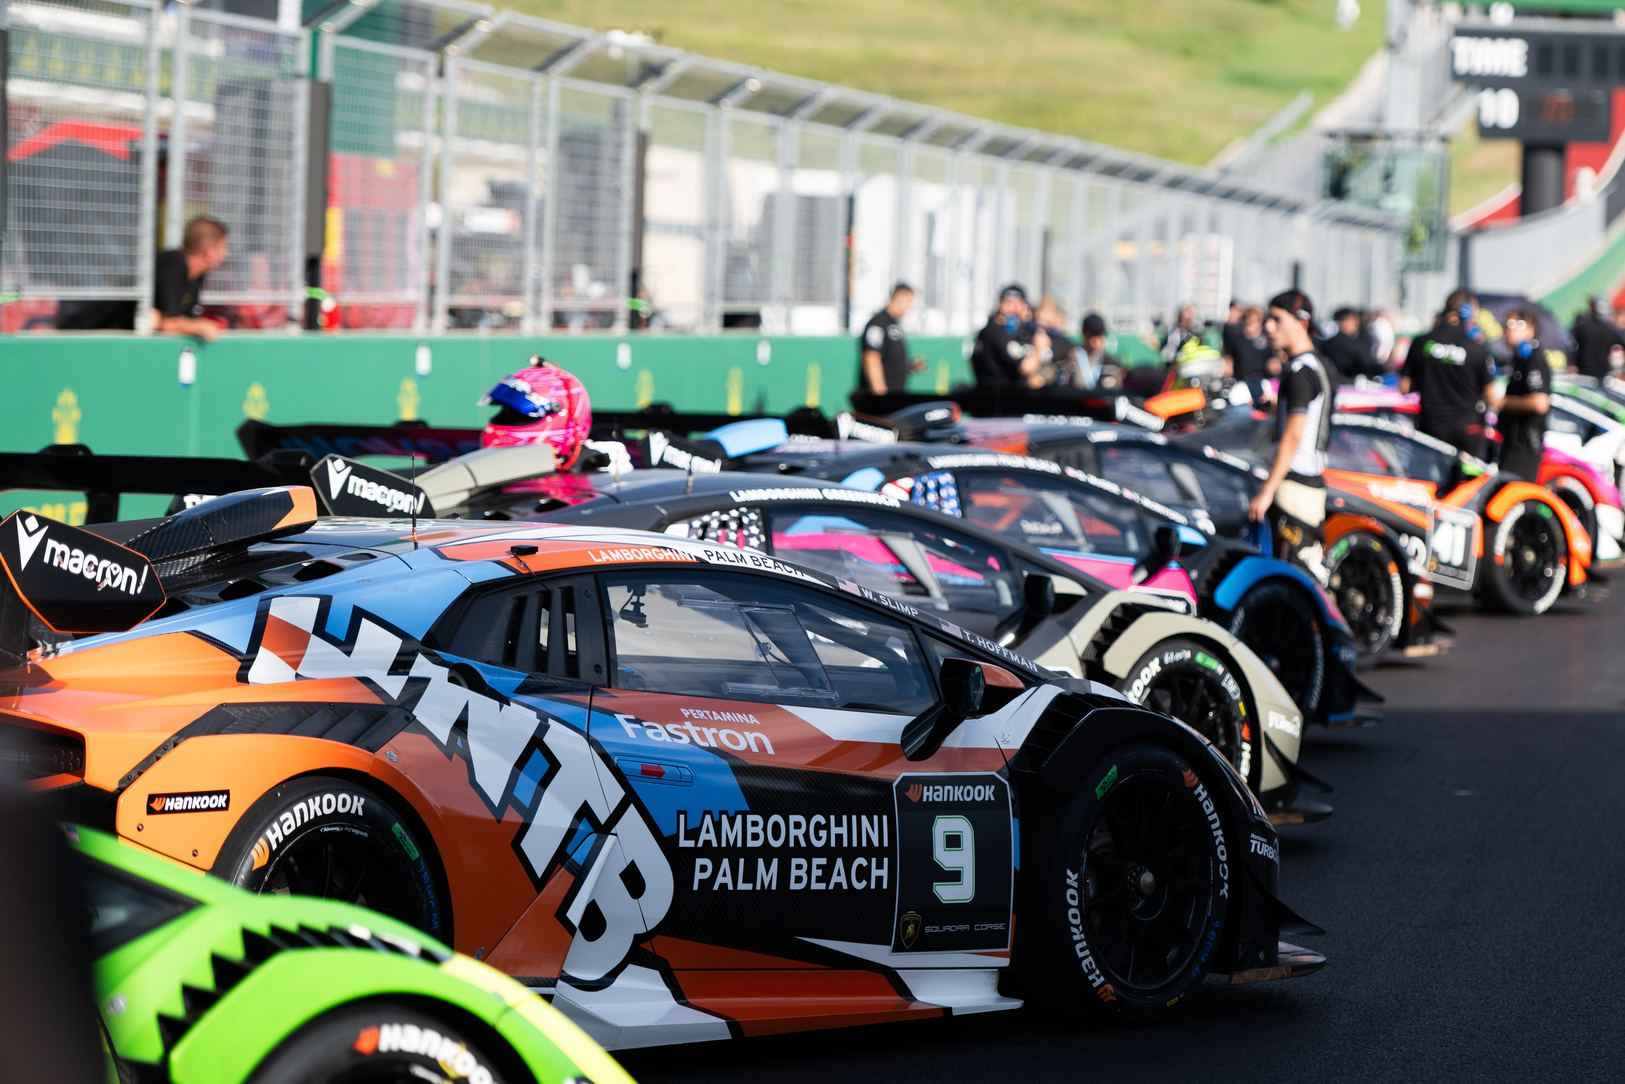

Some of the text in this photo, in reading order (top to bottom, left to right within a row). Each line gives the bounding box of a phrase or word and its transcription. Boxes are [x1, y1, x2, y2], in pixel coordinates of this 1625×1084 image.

[588, 547, 699, 563] LAMBORGHINI
[704, 550, 748, 566] PALM
[861, 587, 919, 617] W. SLIMP
[963, 630, 1038, 672] T. HOFFMAN
[680, 708, 760, 725] PERTAMINA
[614, 713, 775, 755] Fastron
[164, 793, 228, 811] HANKOOK
[922, 785, 996, 802] HANKOOK
[265, 793, 366, 851] HANKOOK
[679, 814, 889, 848] LAMBORGHINI
[693, 857, 889, 891] PALM BEACH
[932, 815, 976, 904] 9
[924, 923, 1007, 933] SQUADRA CORSE
[1066, 868, 1106, 989] HANKOOK
[378, 1023, 500, 1084] HANKOO
